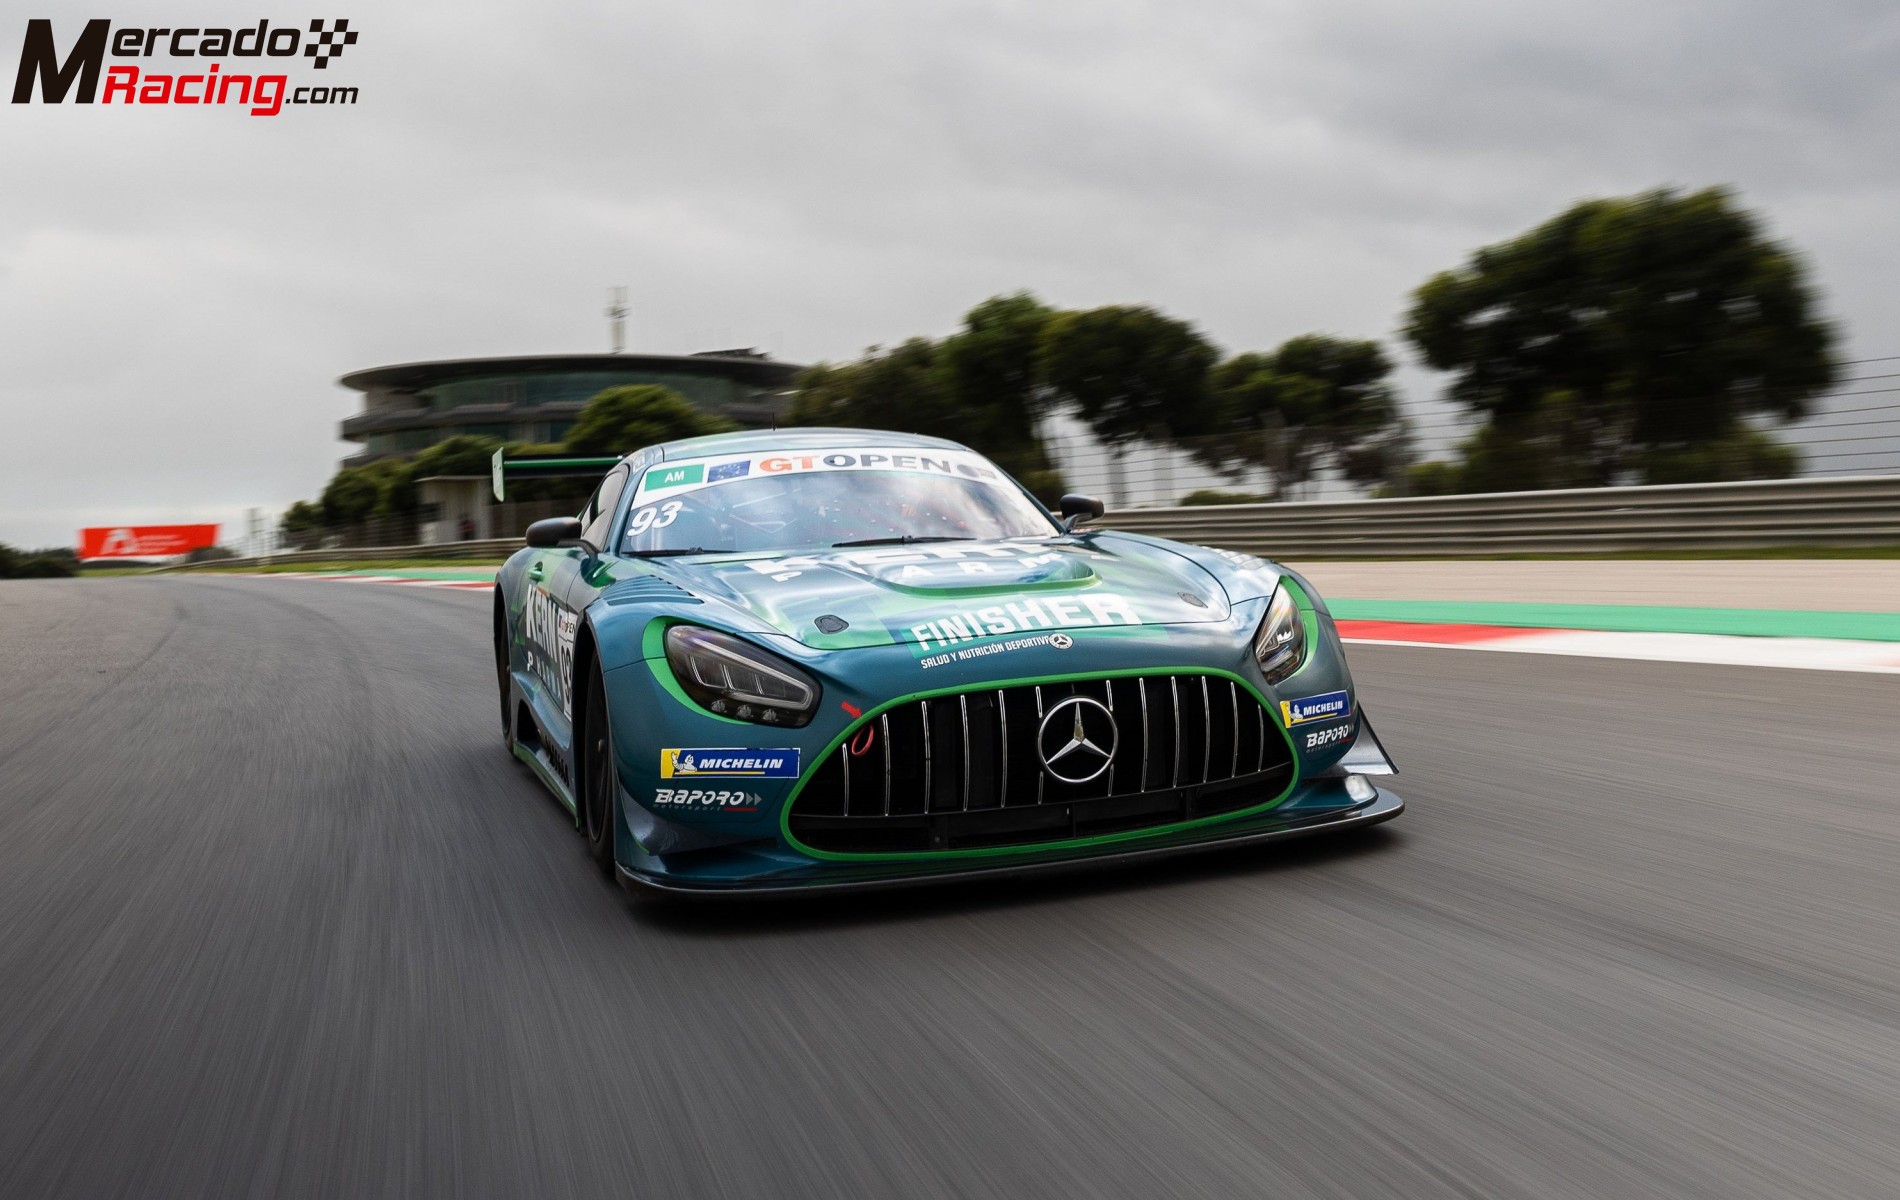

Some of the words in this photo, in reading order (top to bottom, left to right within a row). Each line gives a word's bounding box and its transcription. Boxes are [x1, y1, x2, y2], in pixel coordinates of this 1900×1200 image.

[664, 470, 685, 483] AM
[627, 500, 684, 537] 93
[910, 593, 1143, 652] FINISHER
[920, 653, 951, 669] SALUD
[950, 651, 958, 662] Y
[960, 643, 1005, 660] NUTRICIÓN
[1303, 700, 1343, 716] MICHELIN
[699, 758, 784, 769] MICHELIN
